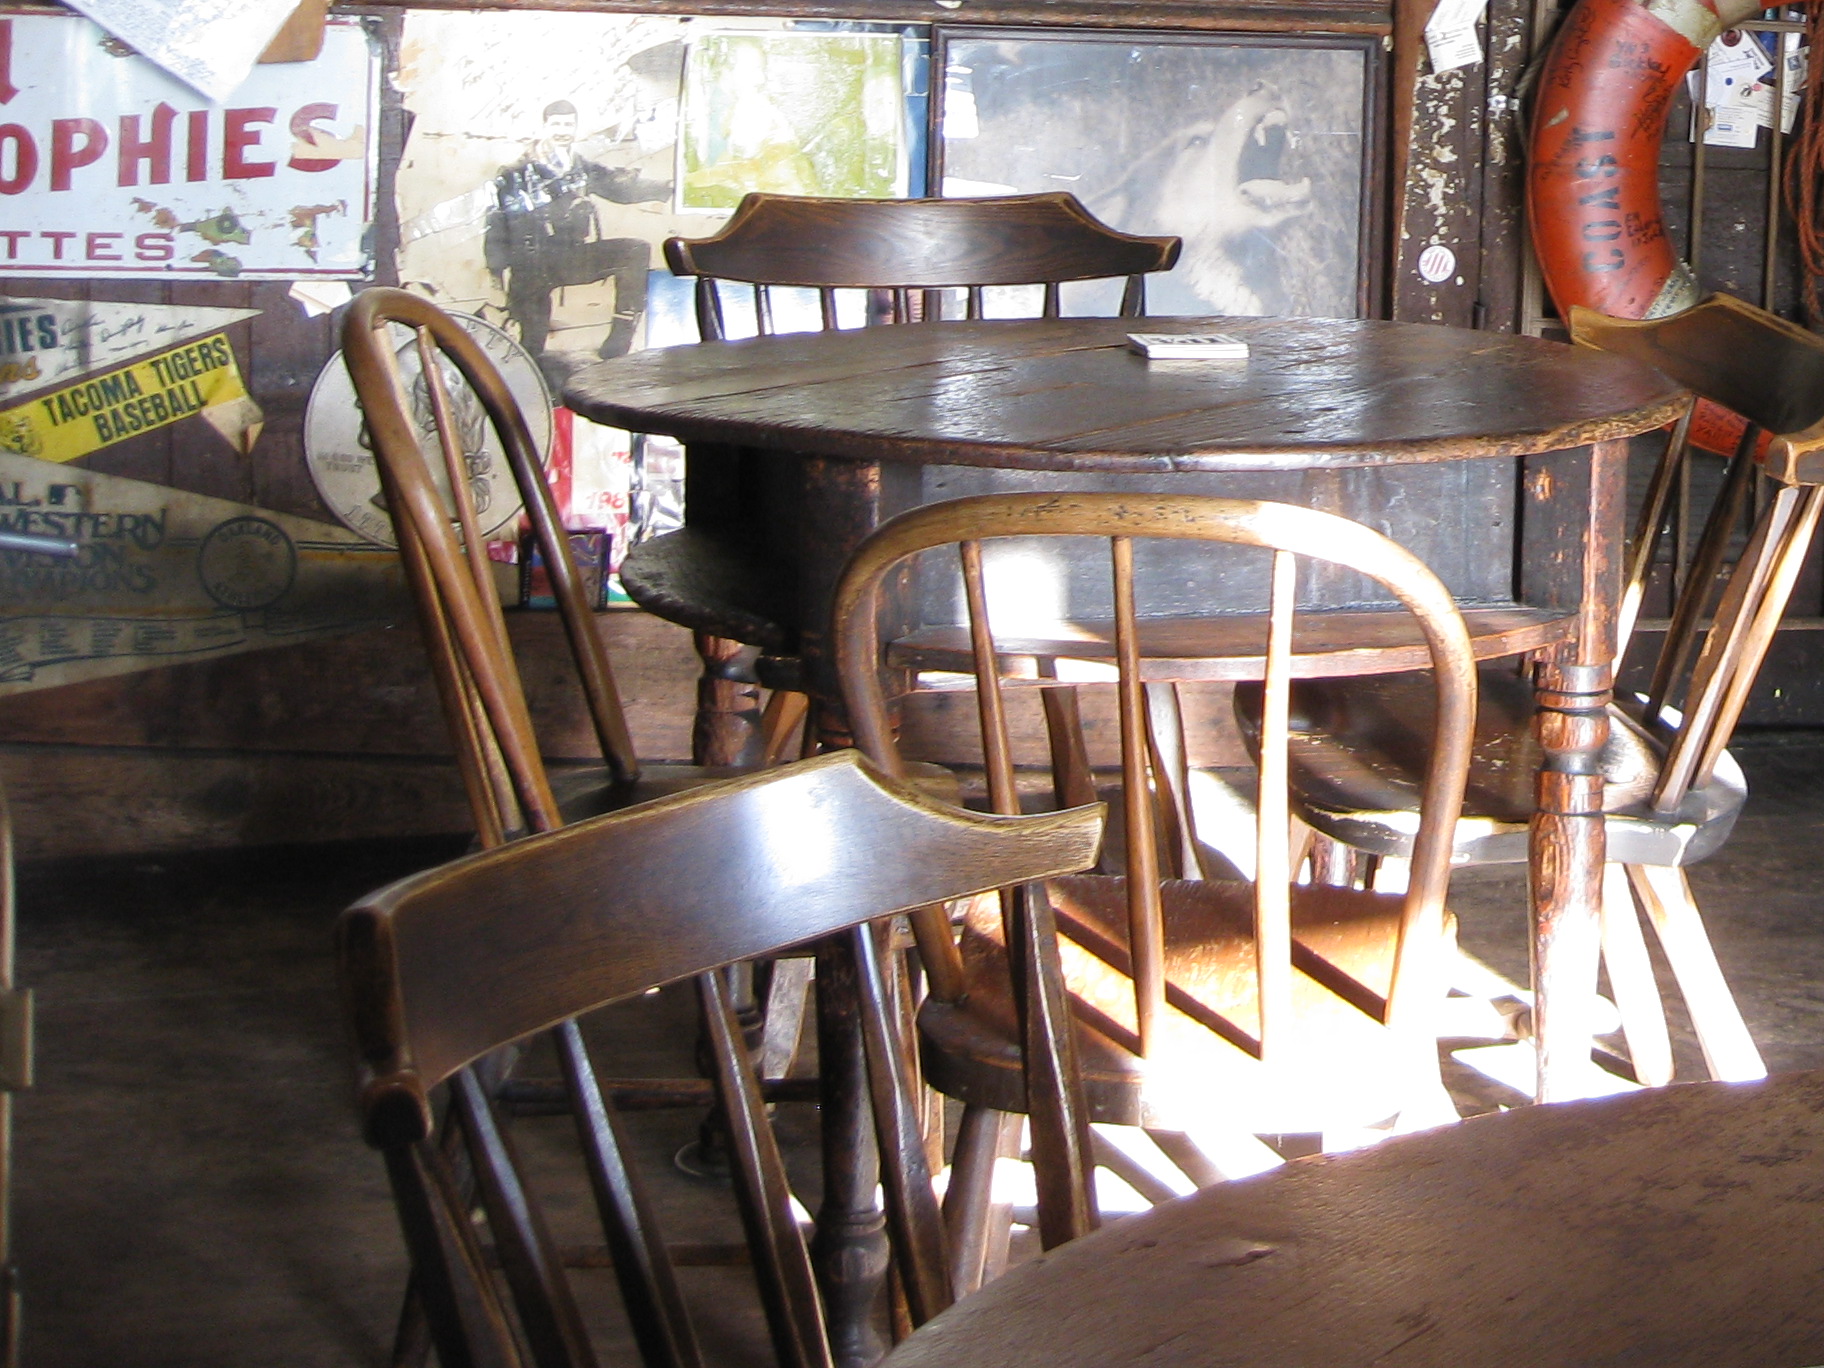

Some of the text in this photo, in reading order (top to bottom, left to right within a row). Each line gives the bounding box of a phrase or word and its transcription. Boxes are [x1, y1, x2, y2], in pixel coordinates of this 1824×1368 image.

[1572, 127, 1626, 273] COAST
[41, 337, 230, 427] TACOMA TIGERS
[92, 380, 208, 443] BASEBALL
